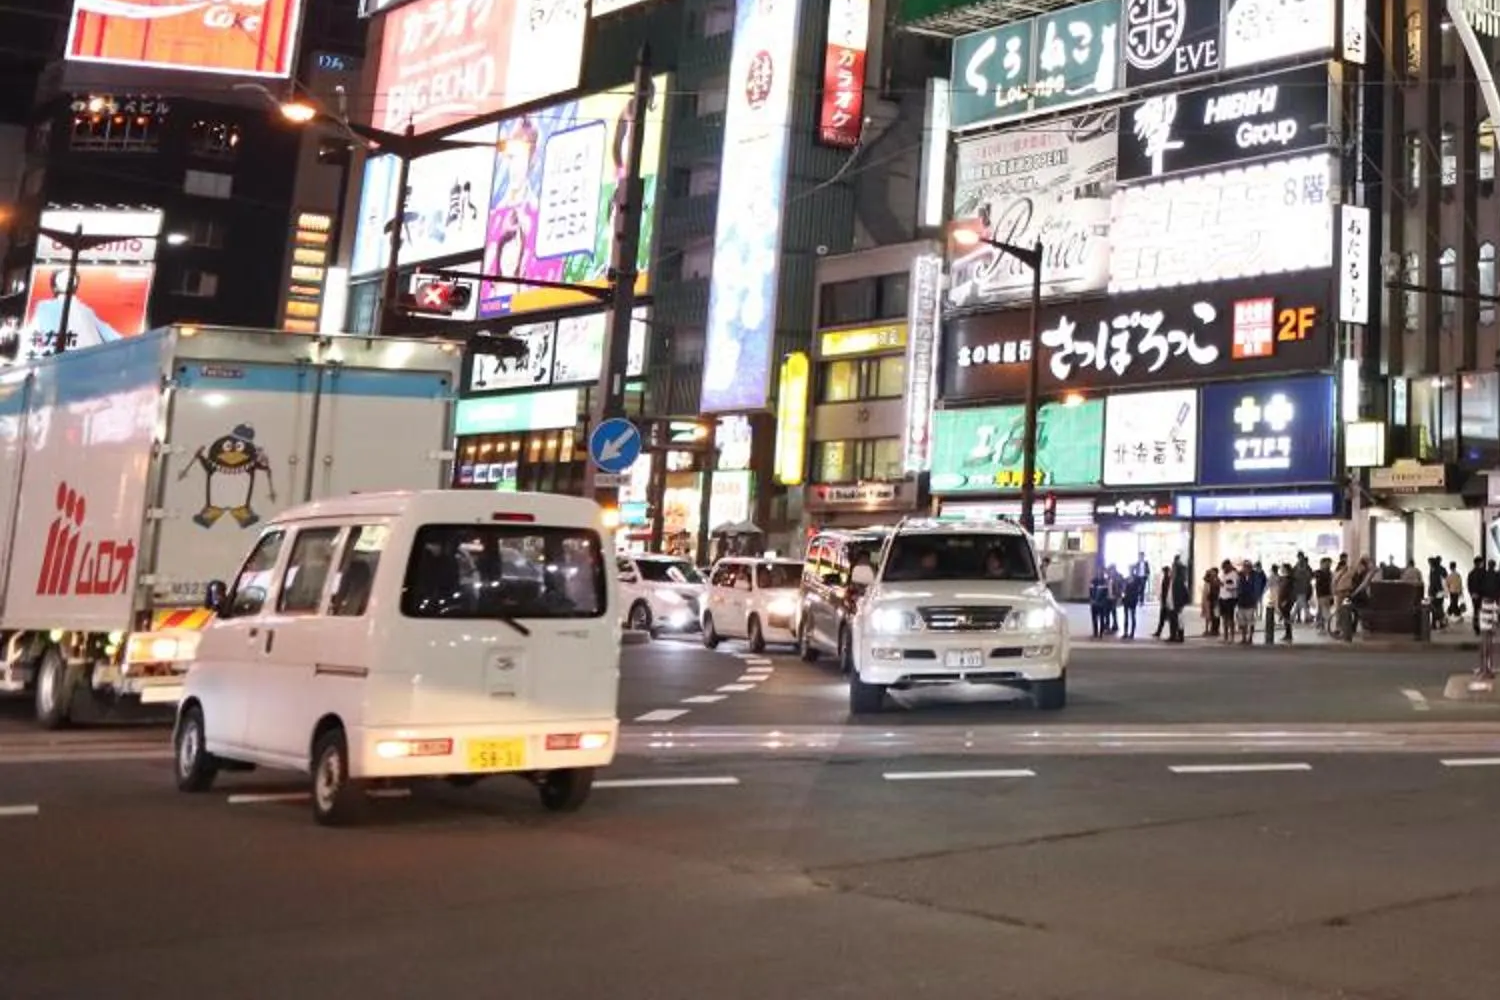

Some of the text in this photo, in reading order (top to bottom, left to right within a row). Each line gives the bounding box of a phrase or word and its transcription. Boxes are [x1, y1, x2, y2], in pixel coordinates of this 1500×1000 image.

[1175, 39, 1218, 74] EVE
[385, 78, 430, 133] BIG
[432, 54, 496, 108] ECHO
[831, 48, 857, 128] カラオケ
[1236, 118, 1299, 150] Group
[1283, 173, 1326, 207] 8階
[1277, 306, 1317, 342] 2F
[75, 537, 136, 595] ムロオ
